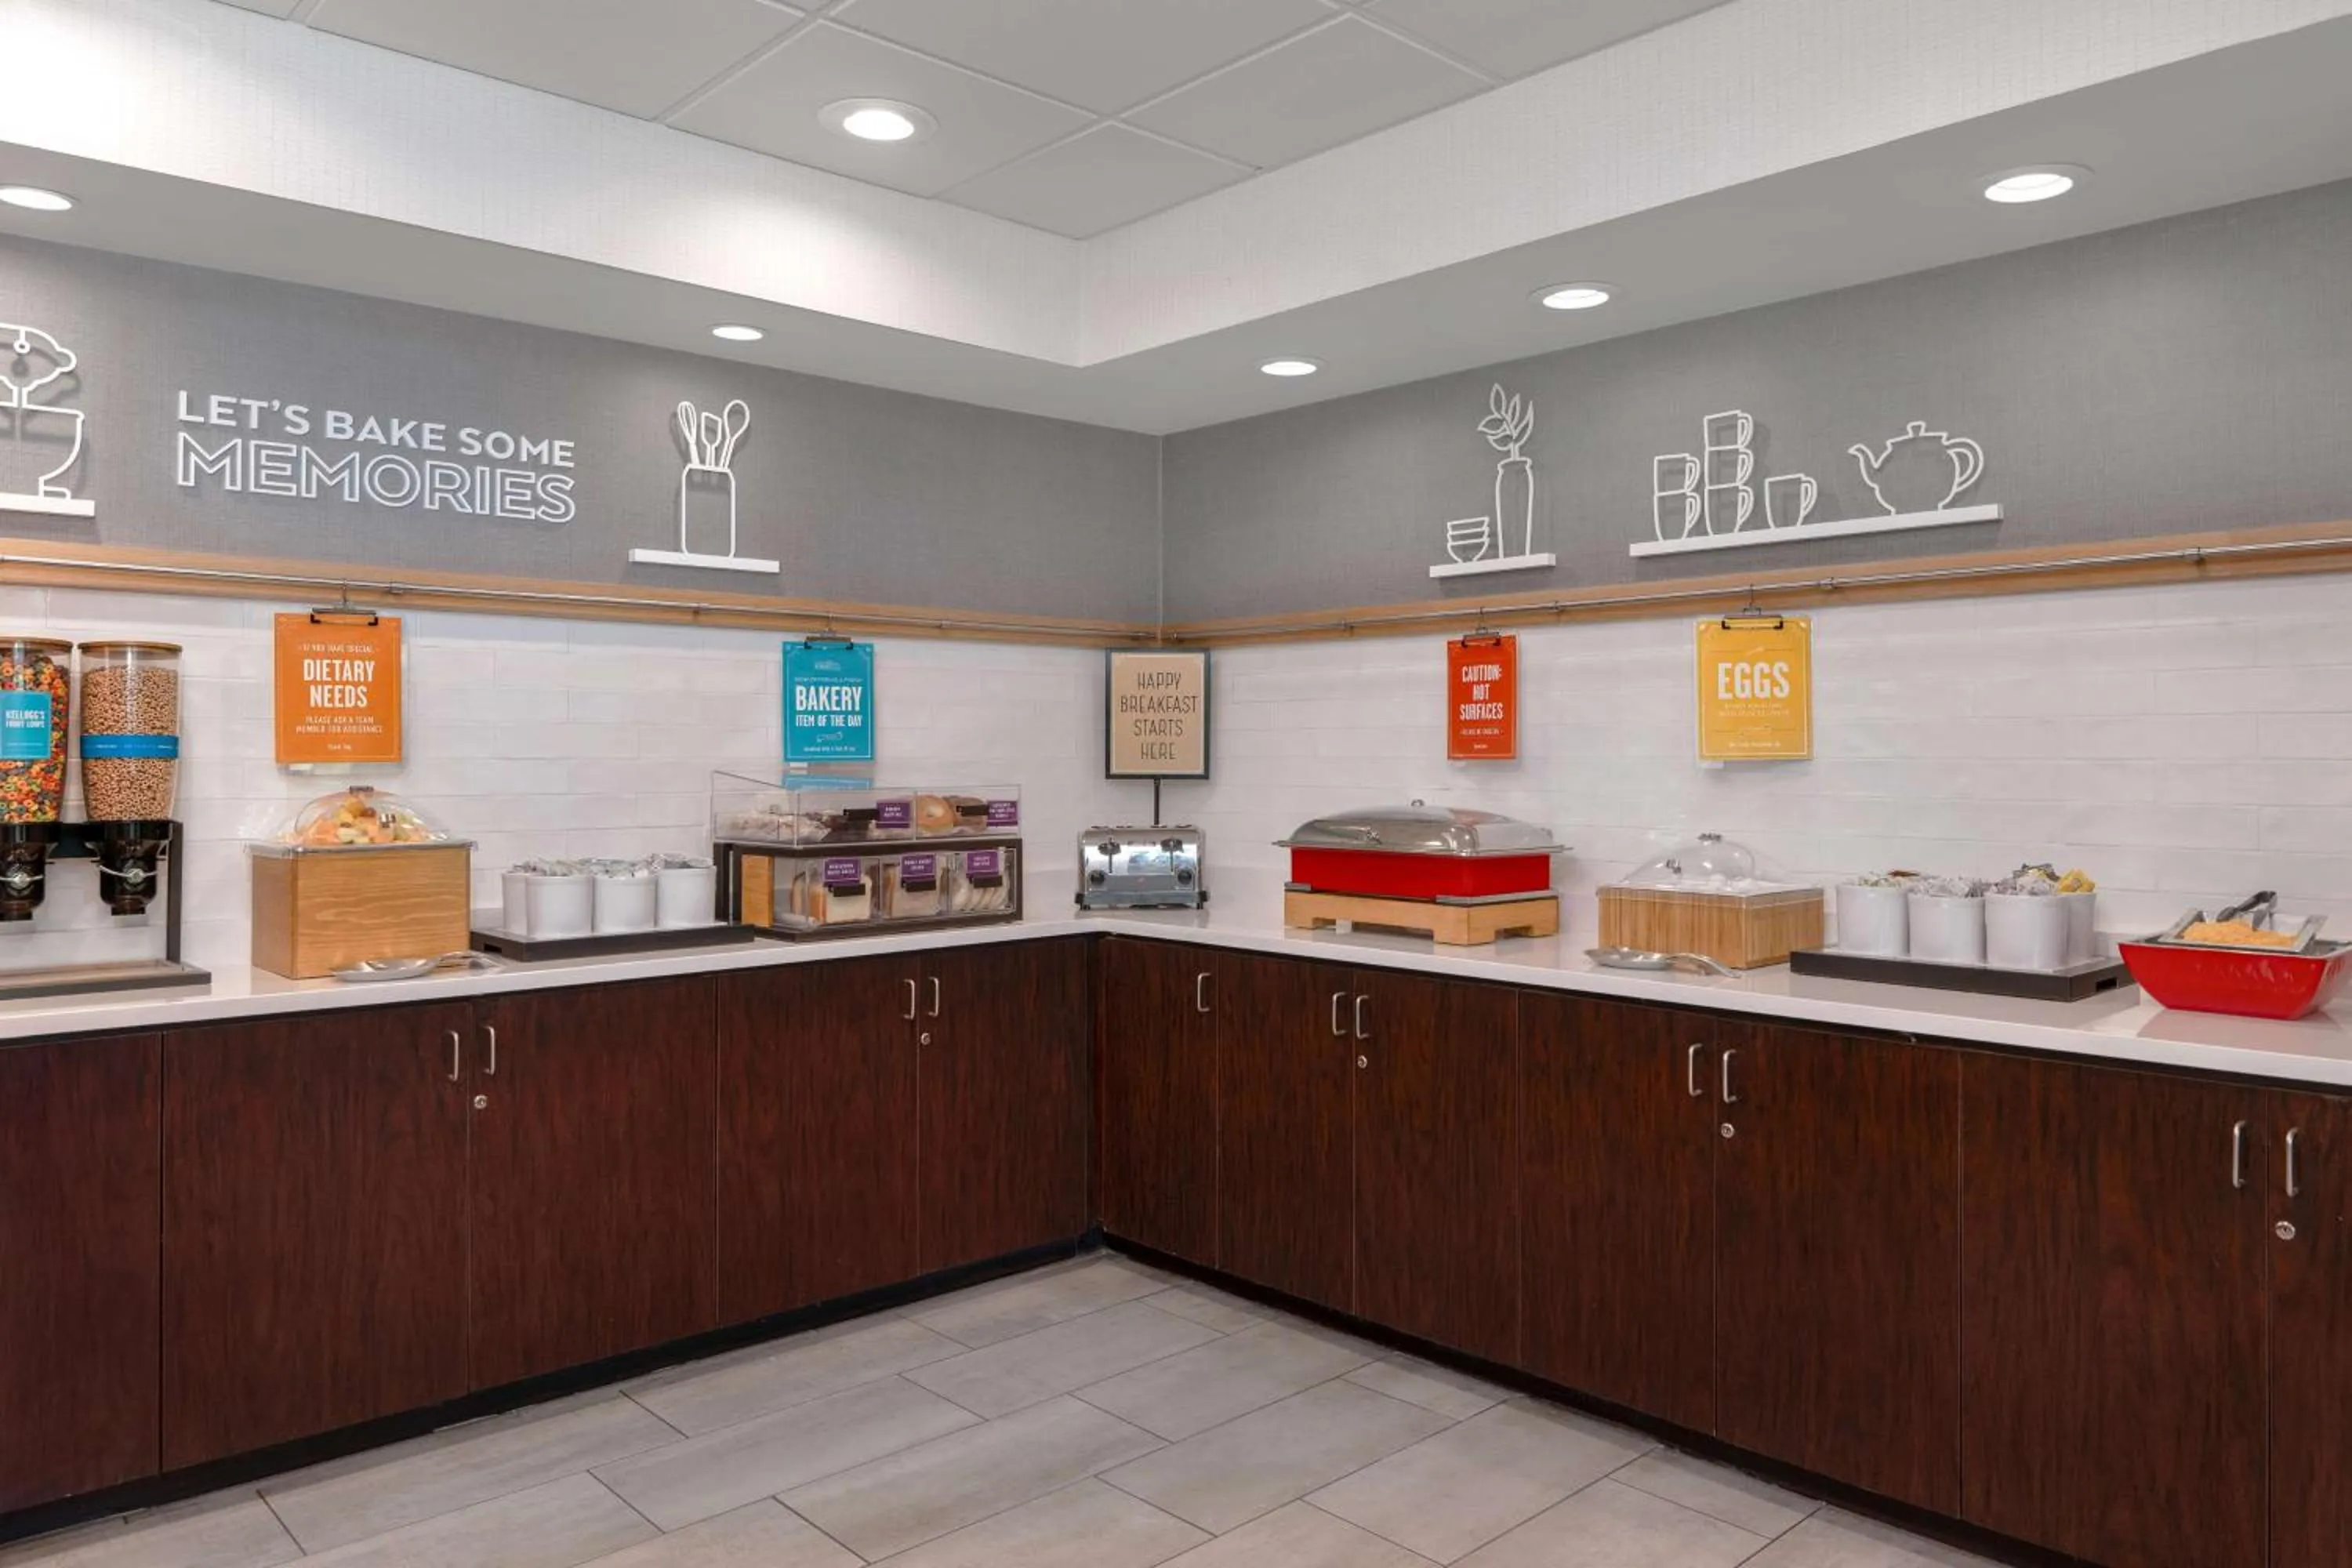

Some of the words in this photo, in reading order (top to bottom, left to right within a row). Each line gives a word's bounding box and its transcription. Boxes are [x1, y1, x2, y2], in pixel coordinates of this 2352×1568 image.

[177, 390, 310, 436] LET'S
[325, 410, 447, 452] BAKE
[458, 426, 575, 468] SOME
[176, 431, 576, 523] MEMORIES
[303, 659, 376, 682] DIETARY
[1137, 671, 1182, 691] HAPPY
[1718, 661, 1791, 701] EGGS
[310, 684, 368, 708] NEEDS
[795, 685, 862, 711] BAKERY
[1472, 683, 1490, 701] HOT
[1120, 695, 1199, 714] BREAKFAST
[1459, 702, 1504, 721] SURFACES
[796, 714, 815, 728] ITEM
[817, 714, 828, 728] OF
[830, 714, 846, 728] THE
[848, 714, 862, 728] DAY
[1133, 718, 1184, 737] STARTS
[1140, 742, 1178, 760] HERE
